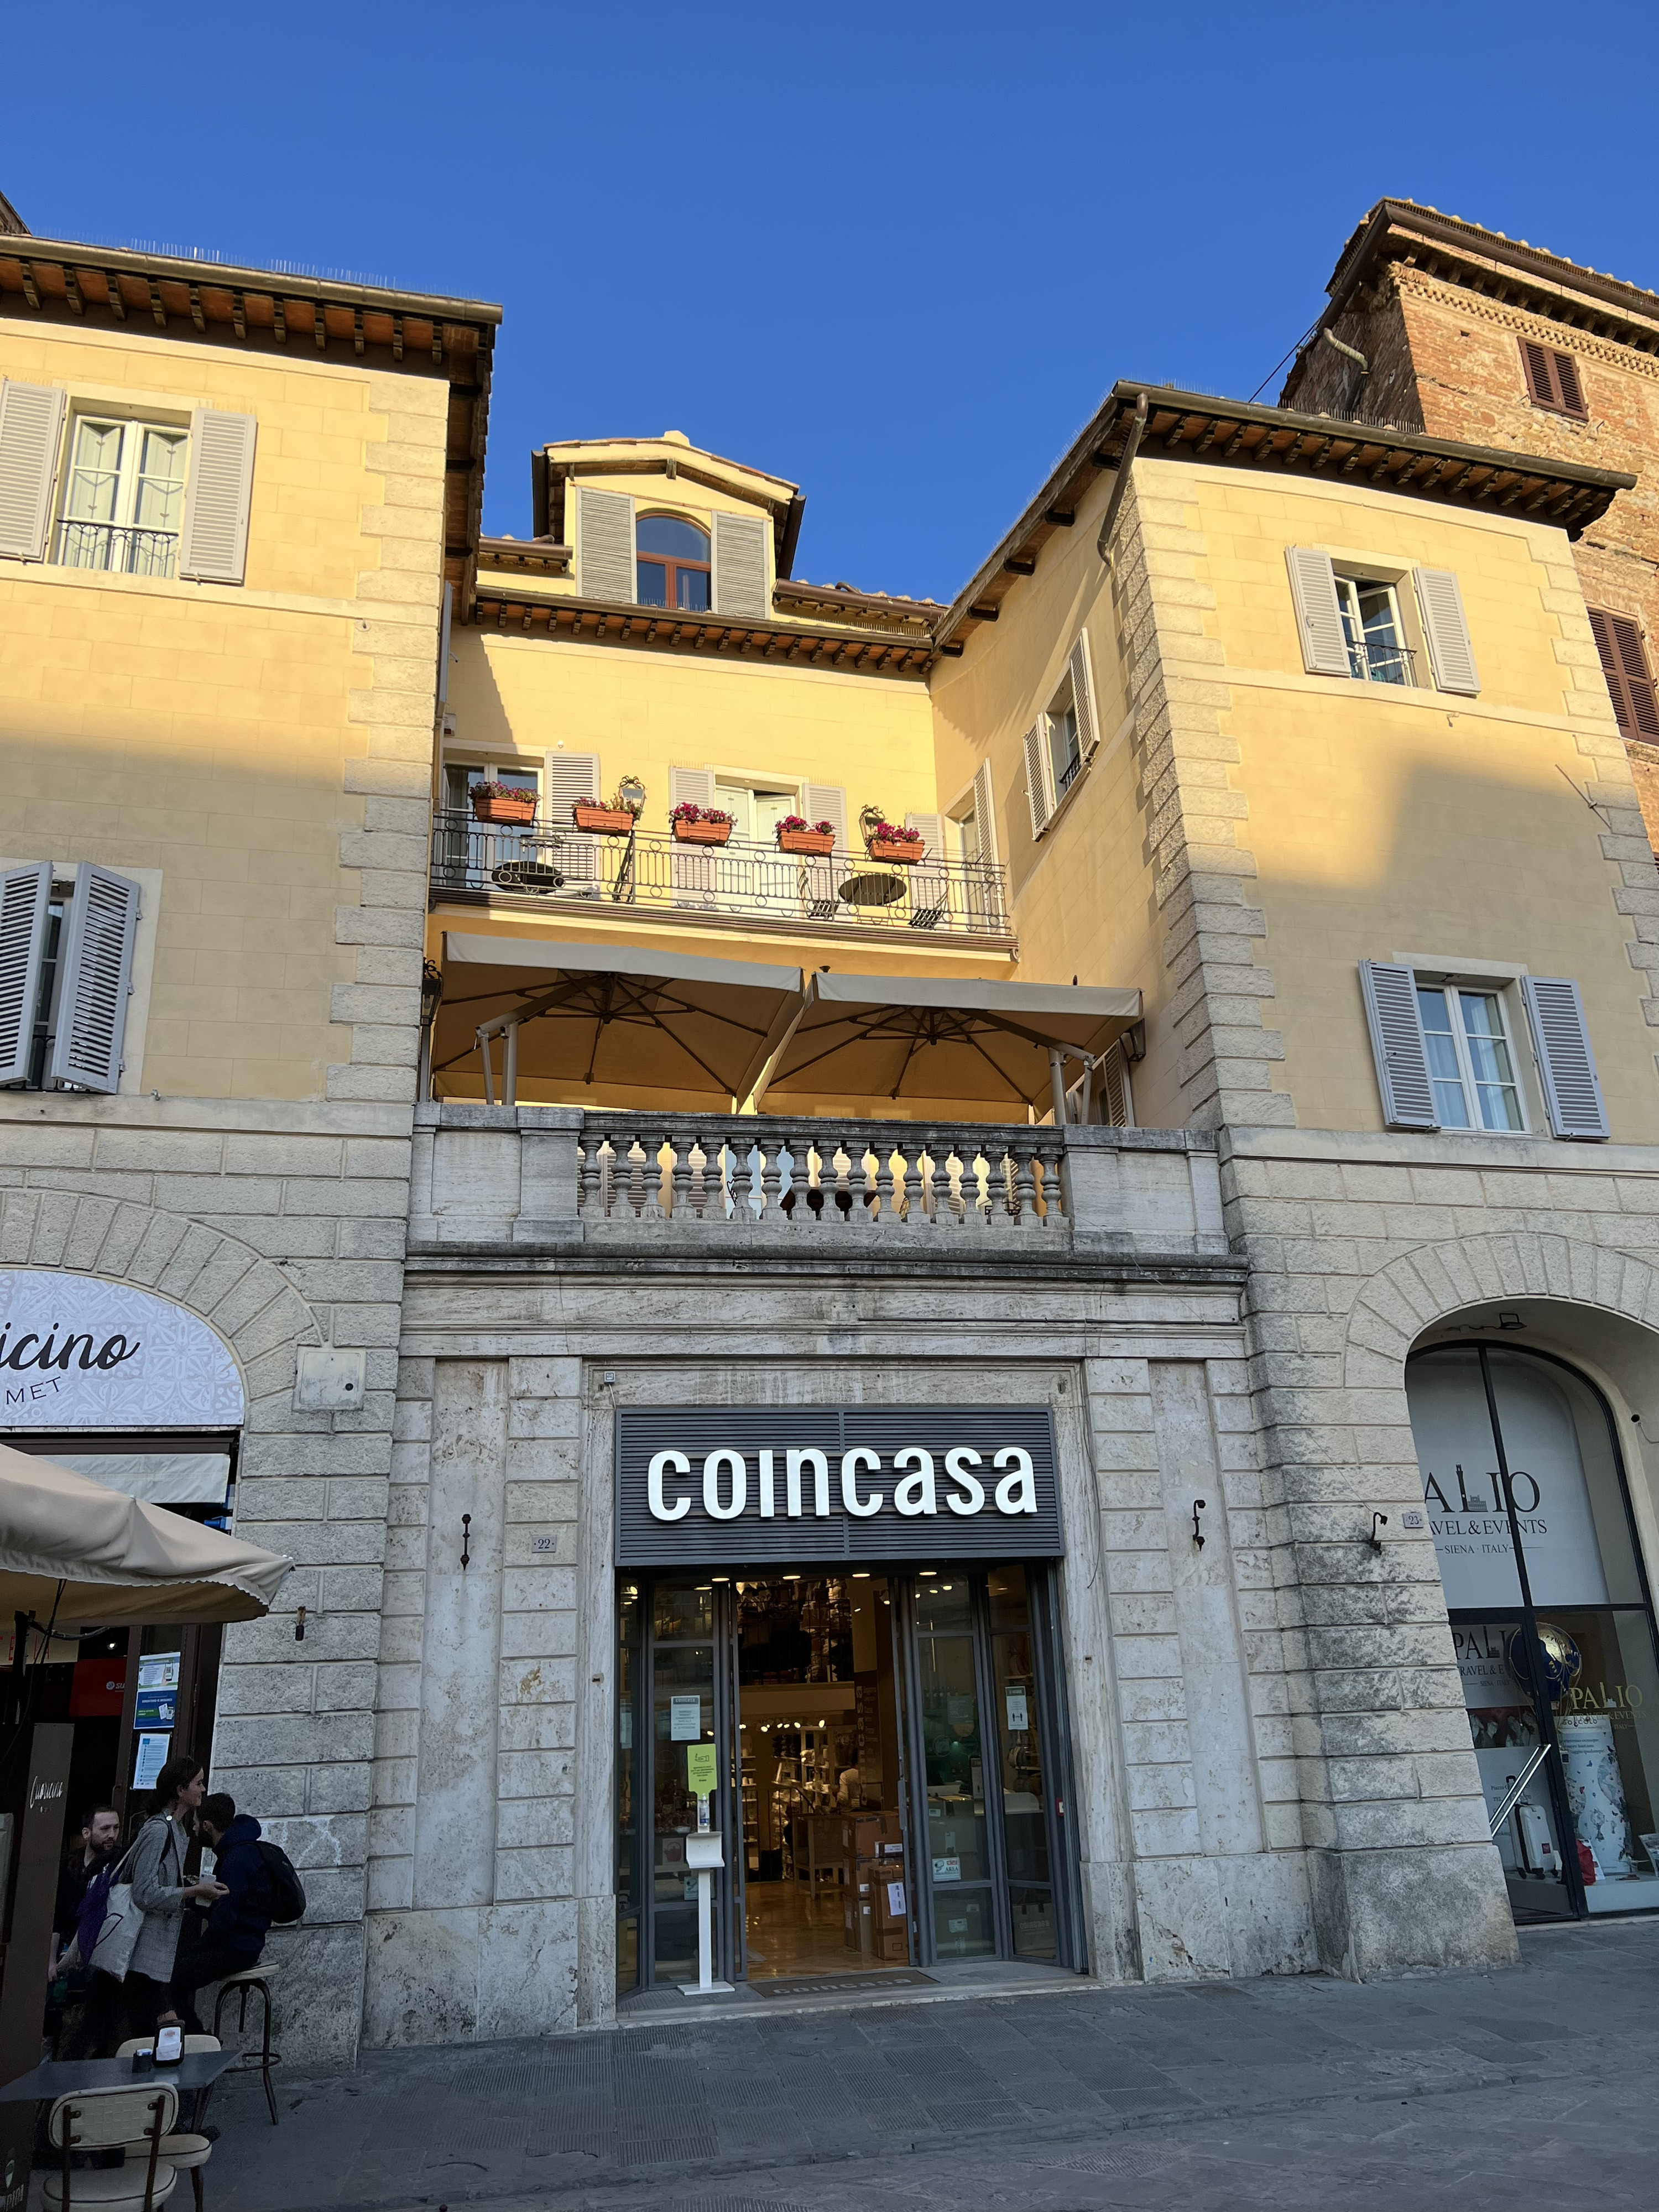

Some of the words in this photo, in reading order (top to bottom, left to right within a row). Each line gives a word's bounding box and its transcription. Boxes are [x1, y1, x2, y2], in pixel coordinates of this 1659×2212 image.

[6, 1376, 61, 1405] MET
[647, 1446, 1039, 1521] coincasa
[1408, 1516, 1420, 1525] 23
[1444, 1545, 1475, 1554] SIENA
[1482, 1544, 1509, 1553] ITALY
[1457, 1665, 1488, 1676] RAVEL
[1569, 1682, 1643, 1710] PALIO
[773, 1978, 912, 1995] coincasa
